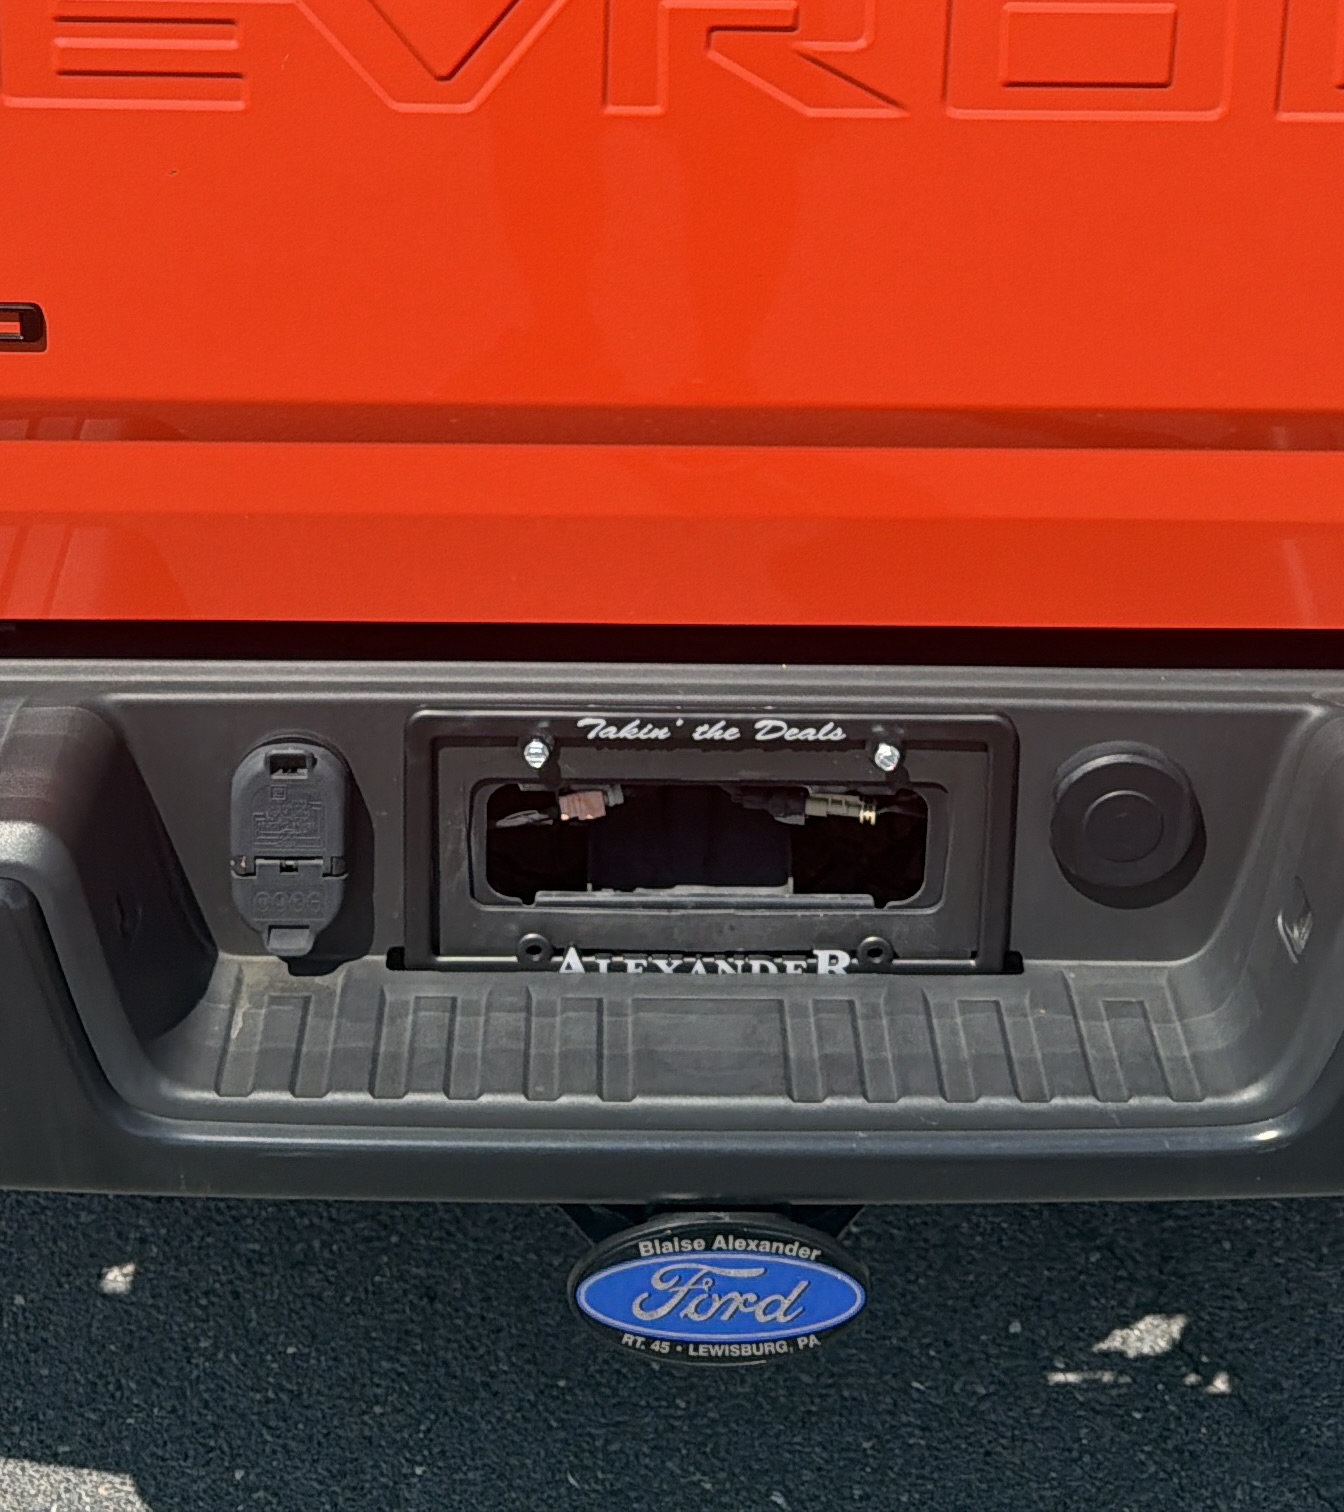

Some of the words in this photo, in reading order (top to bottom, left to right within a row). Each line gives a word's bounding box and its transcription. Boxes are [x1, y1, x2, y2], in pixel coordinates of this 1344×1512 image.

[577, 717, 684, 740] Takin'
[692, 720, 742, 741] the
[754, 719, 847, 741] Deals
[638, 1236, 706, 1258] Blaise
[712, 1234, 823, 1262] Alexander
[631, 1262, 810, 1325] Ford
[621, 1333, 647, 1351] RT.
[651, 1340, 671, 1355] 45
[688, 1340, 794, 1357] LEWISBURG,
[798, 1335, 821, 1351] PA
